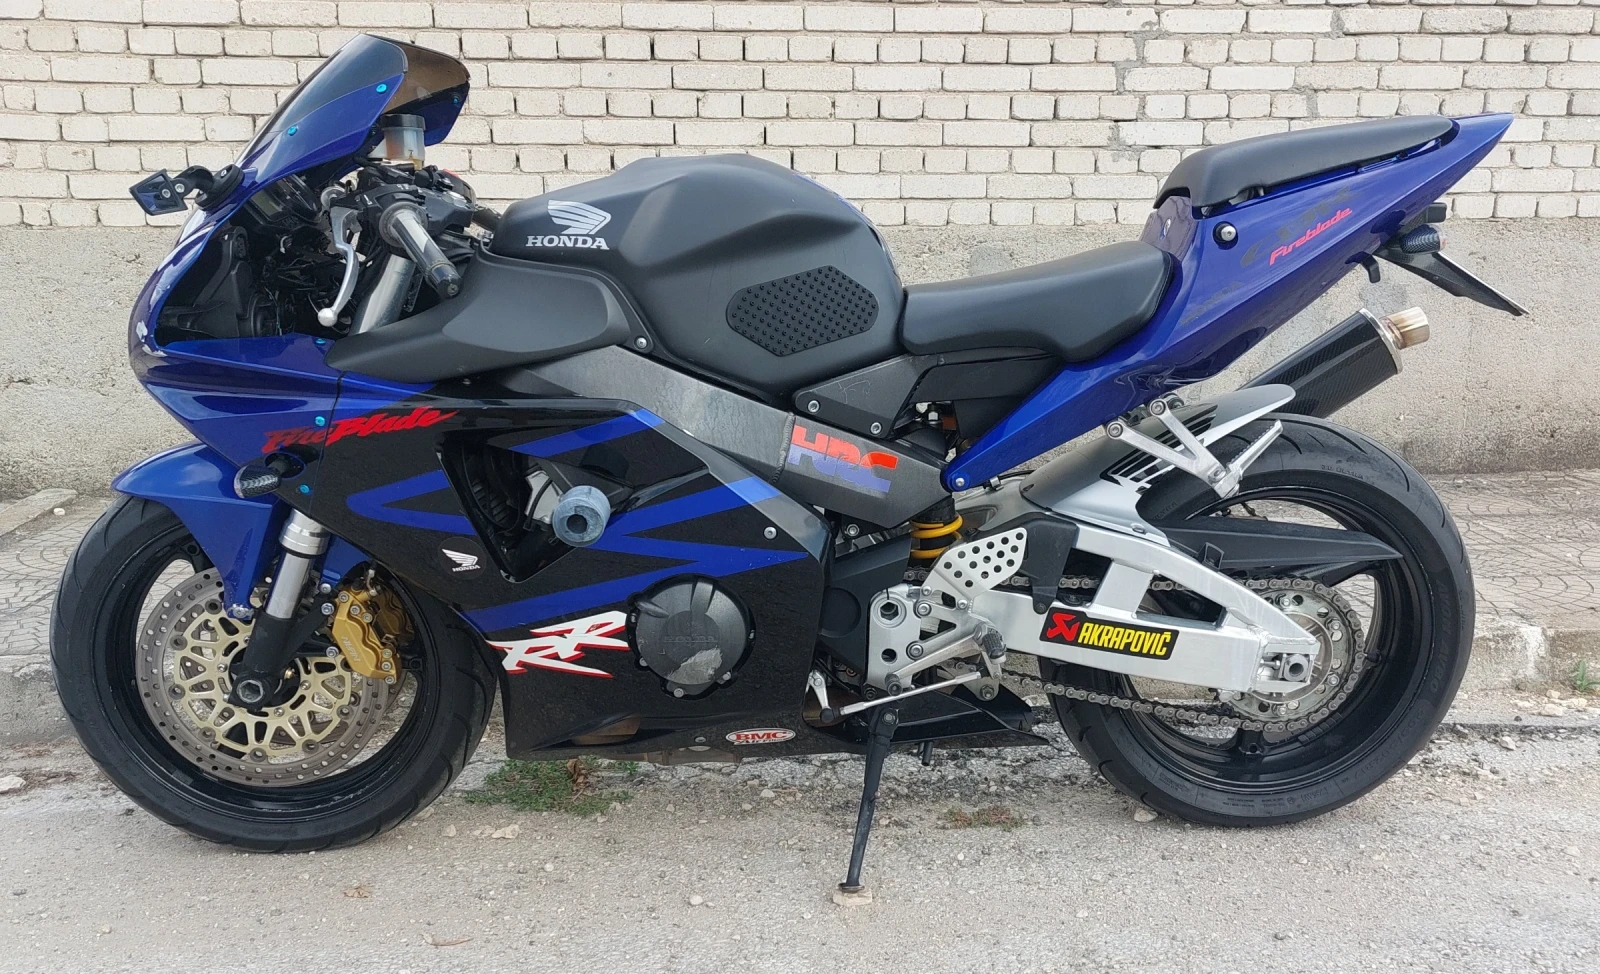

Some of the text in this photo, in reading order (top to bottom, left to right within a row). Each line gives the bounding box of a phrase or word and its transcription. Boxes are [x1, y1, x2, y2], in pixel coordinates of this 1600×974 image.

[525, 235, 610, 250] HONDA
[1269, 207, 1352, 266] Fireblade
[788, 424, 899, 493] HRC
[735, 731, 787, 741] BMC
